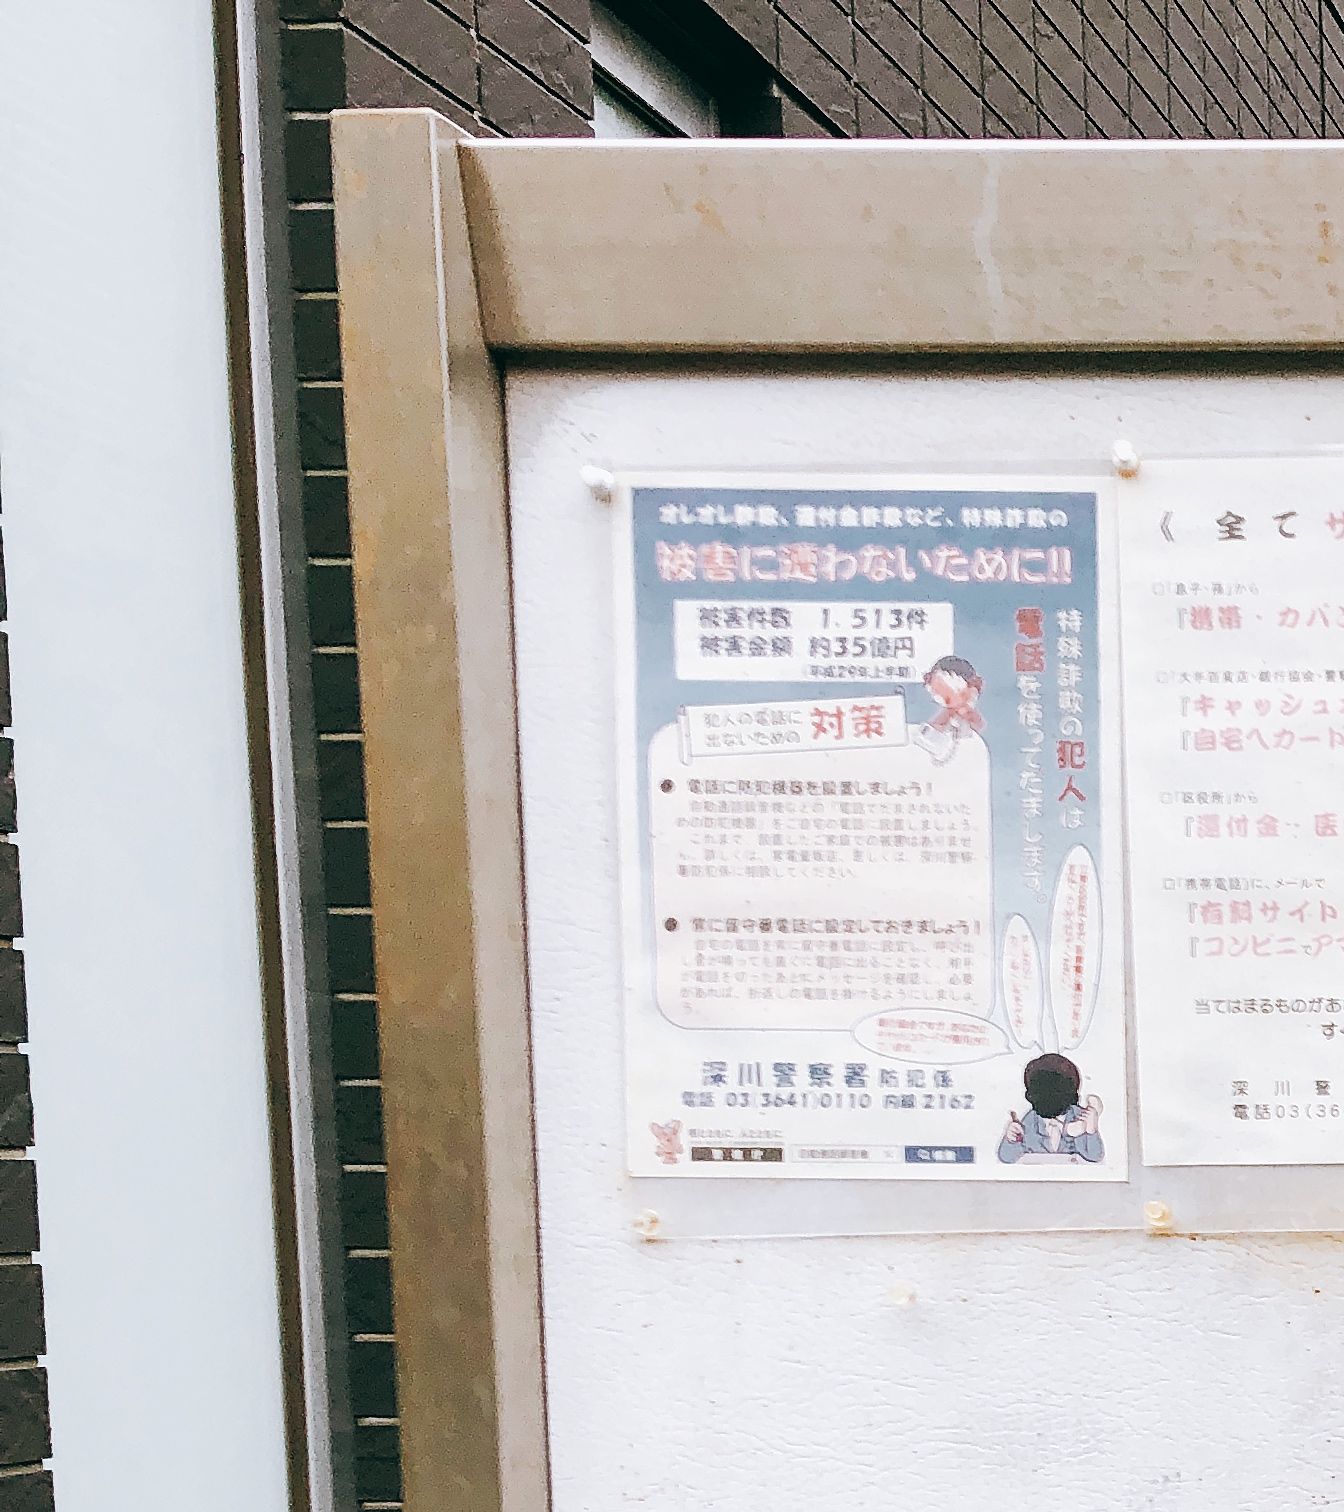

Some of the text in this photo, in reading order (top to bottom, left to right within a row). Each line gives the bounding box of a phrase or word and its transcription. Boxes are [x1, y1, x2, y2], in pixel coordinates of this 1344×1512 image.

[810, 704, 886, 740] 対策
[1056, 608, 1087, 830] 特殊詐欺の犯人は
